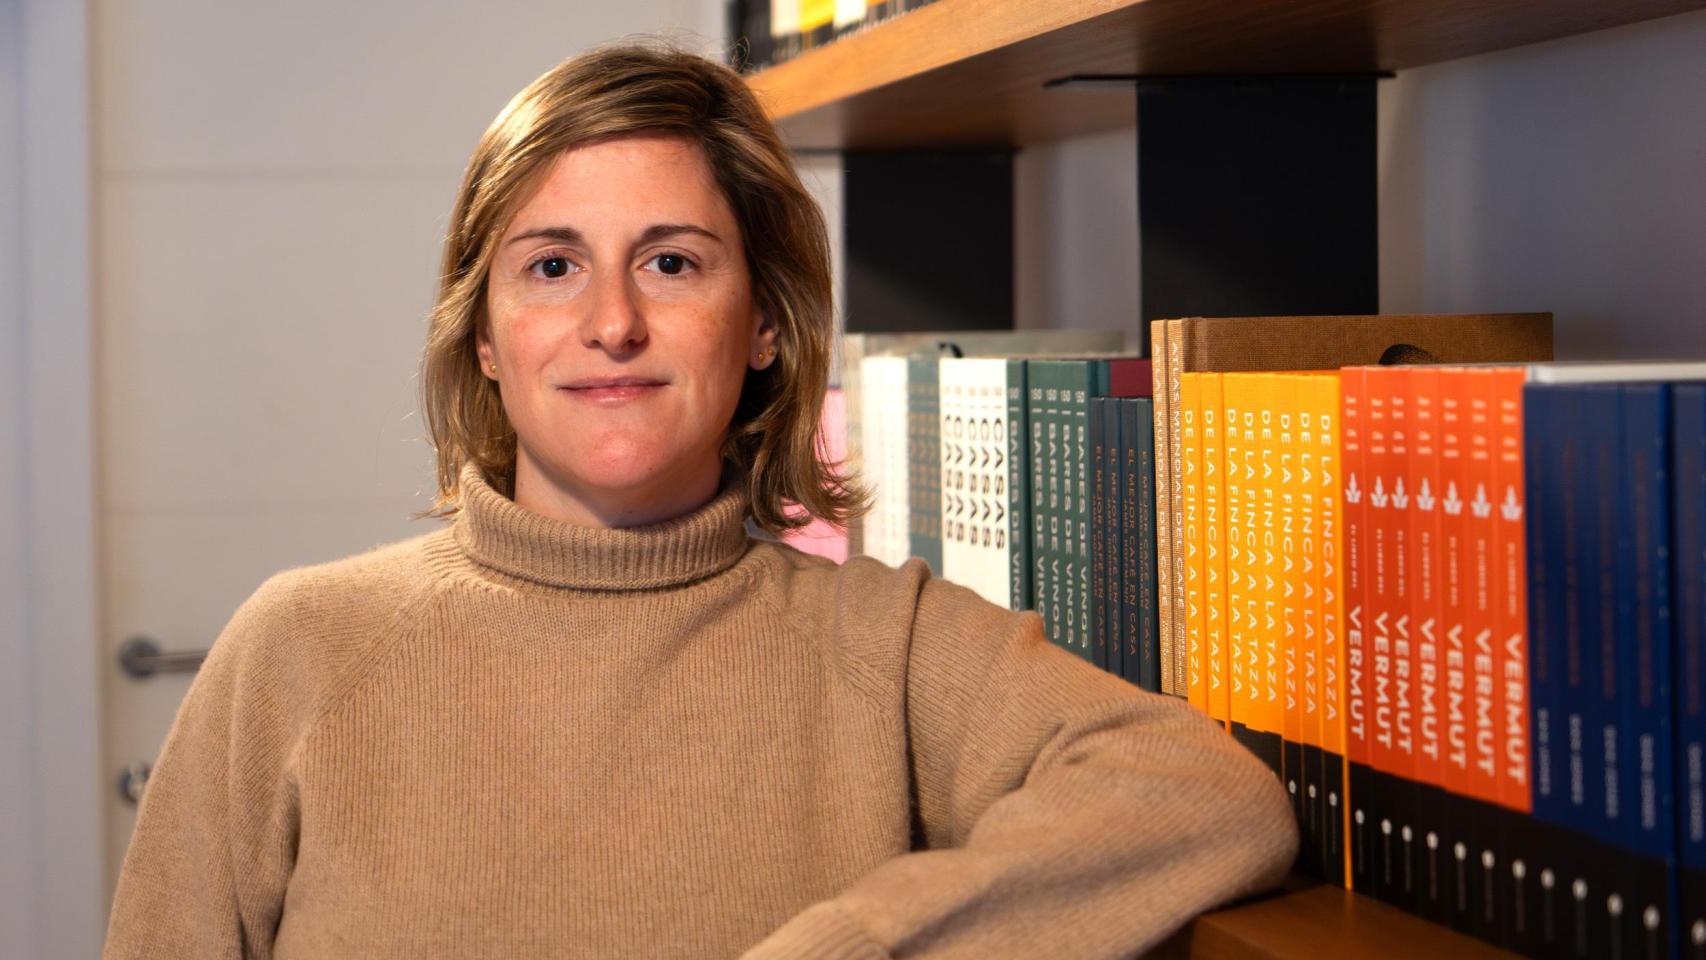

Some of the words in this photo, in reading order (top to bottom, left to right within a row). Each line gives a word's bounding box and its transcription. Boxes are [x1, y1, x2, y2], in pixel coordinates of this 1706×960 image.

[1185, 410, 1194, 437] DE
[1205, 410, 1214, 437] DE
[1228, 409, 1236, 436] DE
[1244, 412, 1253, 440] DE
[1262, 410, 1271, 438] DE
[1281, 414, 1290, 442] DE
[1300, 413, 1310, 442] DE
[1321, 415, 1331, 444] DE
[1010, 421, 1018, 502] BARES
[1034, 422, 1042, 506] BARES
[1049, 423, 1057, 508] BARES
[1174, 411, 1182, 505] MUNDIAL
[1186, 448, 1194, 474] LA
[1206, 448, 1215, 476] LA
[1228, 447, 1237, 475] LA
[1246, 451, 1255, 479] LA
[1264, 450, 1272, 478] LA
[1282, 454, 1291, 483] LA
[1302, 453, 1311, 482] LA
[1322, 456, 1332, 486] LA
[969, 418, 978, 545] CASAS
[981, 418, 990, 547] CASAS
[994, 418, 1004, 549] CASAS
[1012, 511, 1019, 544] DE
[1036, 514, 1043, 548] DE
[1051, 517, 1058, 551] DE
[1065, 520, 1072, 554] DE
[1187, 484, 1196, 556] FINCA
[1208, 486, 1216, 559] FINCA
[1230, 485, 1239, 560] FINCA
[1246, 490, 1256, 564] FINCA
[1264, 488, 1274, 565] FINCA
[1283, 494, 1293, 572] FINCA
[1302, 494, 1312, 572] FINCA
[1323, 497, 1333, 577] FINCA
[1080, 522, 1085, 558] DE
[1012, 552, 1020, 611] VINO
[1037, 556, 1045, 617] VINO
[1189, 567, 1196, 580] A
[1210, 568, 1217, 582] A
[1232, 569, 1239, 584] A
[1248, 575, 1256, 590] A
[1266, 576, 1274, 590] A
[1284, 581, 1293, 596] A
[1304, 583, 1313, 598] A
[1190, 591, 1197, 617] LA
[1210, 593, 1218, 620] LA
[1232, 594, 1240, 622] LA
[1325, 588, 1334, 603] A
[1248, 600, 1257, 628] LA
[1266, 601, 1275, 629] LA
[1284, 608, 1294, 636] LA
[1304, 609, 1314, 640] LA
[1325, 614, 1335, 644] LA
[1190, 628, 1199, 685] TAZA
[1211, 630, 1220, 688] TAZA
[1233, 632, 1242, 692] TAZA
[1249, 640, 1259, 699] TAZA
[1267, 640, 1276, 701] TAZA
[1349, 606, 1364, 740] VERMUT
[1286, 648, 1296, 709] TAZA
[1306, 650, 1316, 713] TAZA
[1327, 656, 1336, 720] TAZA
[1375, 612, 1391, 750] VERMUT
[1396, 616, 1411, 754] VERMUT
[1420, 619, 1437, 761] VERMUT
[1448, 625, 1465, 769] VERMUT
[1476, 629, 1494, 777] VERMUT
[1505, 634, 1525, 785] VERMUT
